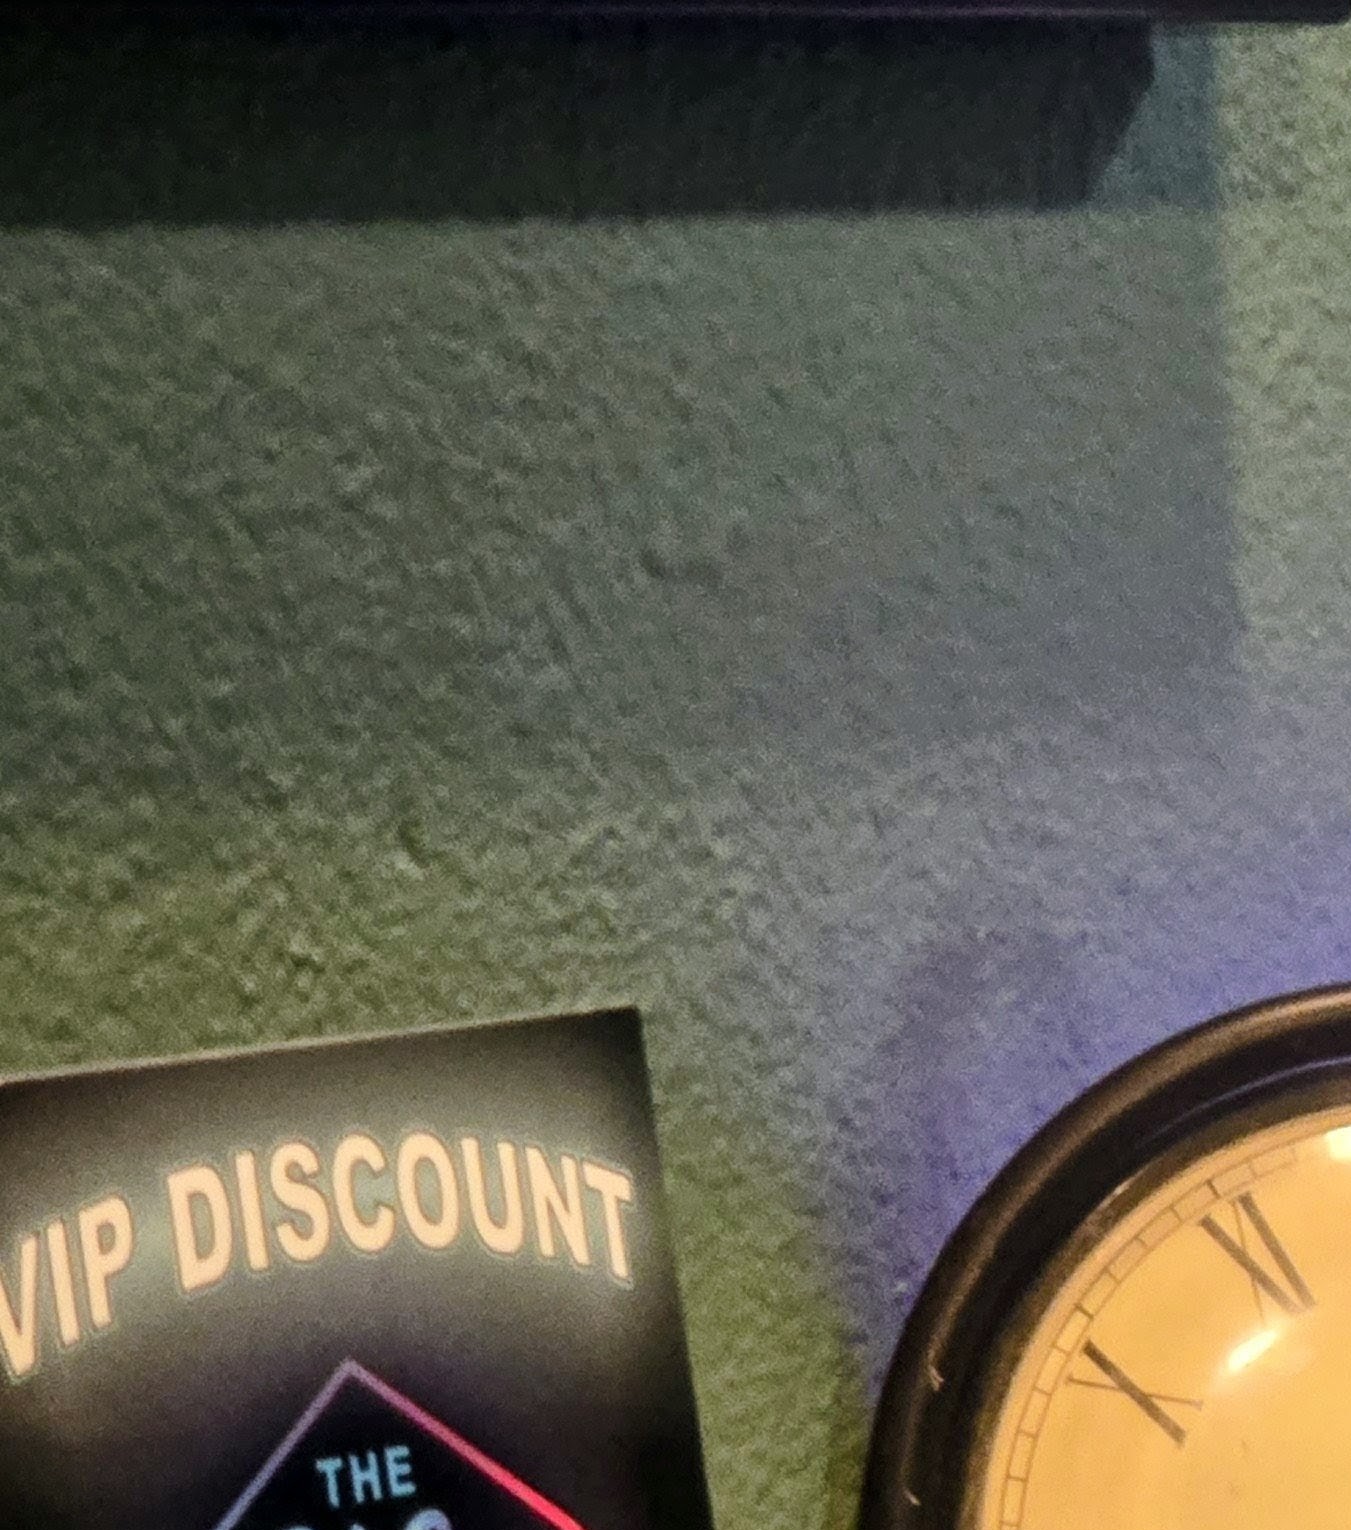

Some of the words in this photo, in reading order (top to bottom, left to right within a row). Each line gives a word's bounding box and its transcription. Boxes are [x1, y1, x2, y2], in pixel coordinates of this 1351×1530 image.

[0, 1194, 134, 1379] VIP
[166, 1130, 634, 1292] DISCOUNT
[1198, 1190, 1317, 1327] XI
[1065, 1338, 1203, 1447] X
[315, 1445, 417, 1507] THE
